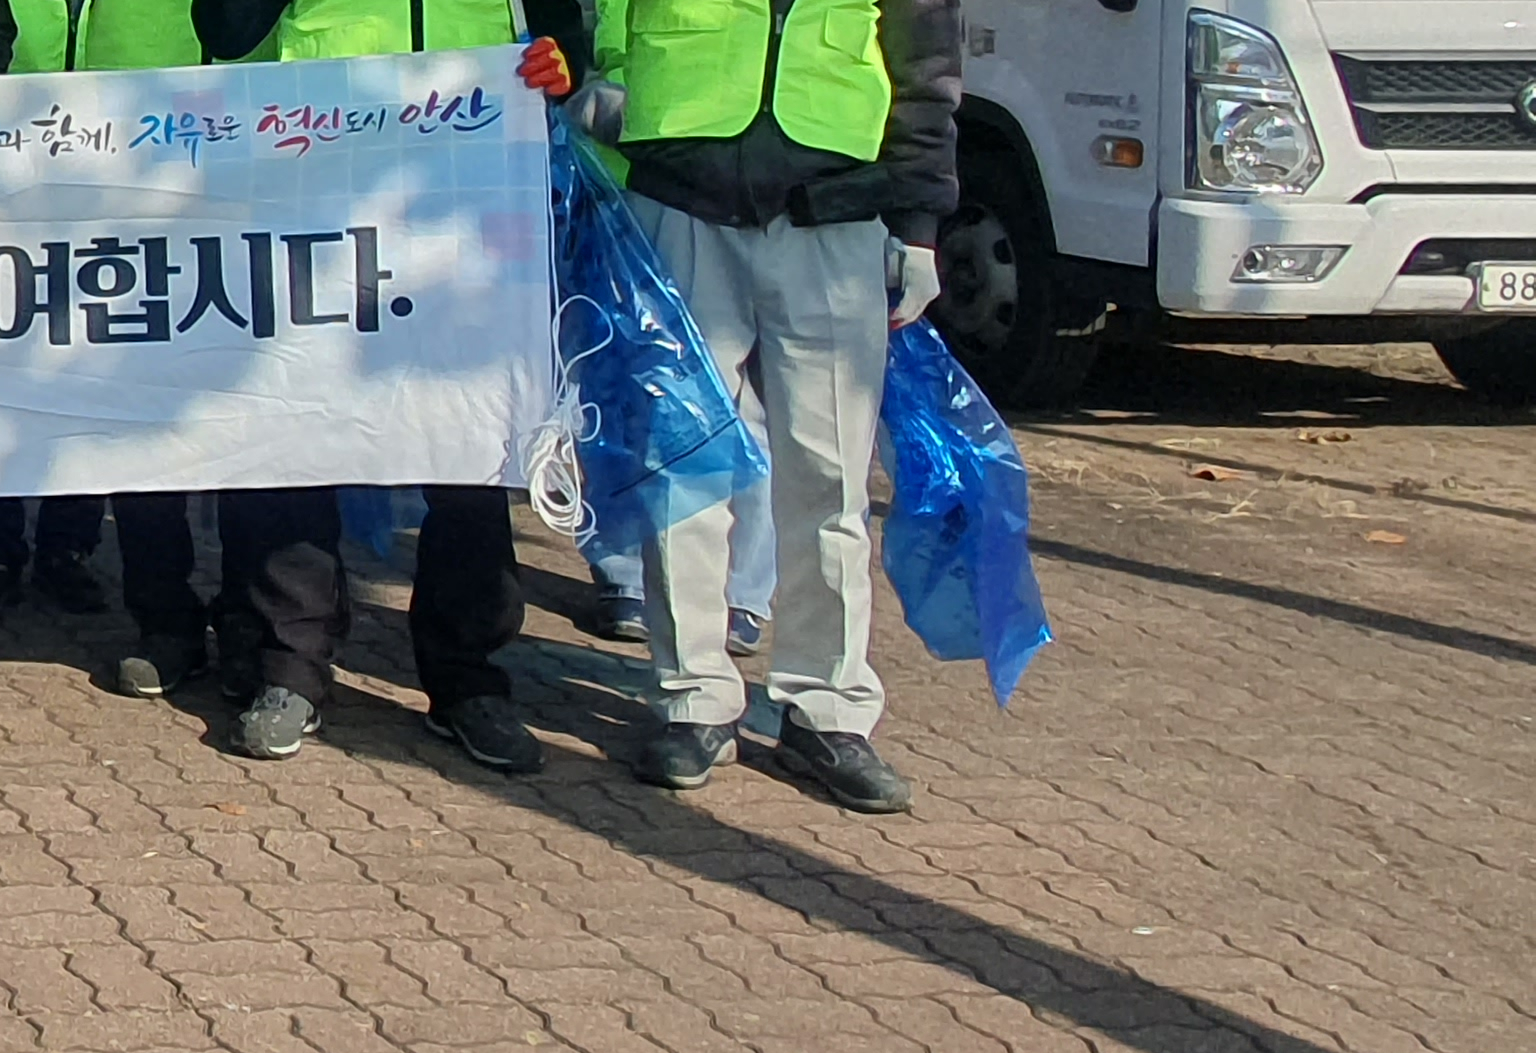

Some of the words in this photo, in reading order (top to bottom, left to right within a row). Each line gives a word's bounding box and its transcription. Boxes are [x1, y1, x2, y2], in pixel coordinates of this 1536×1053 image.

[128, 113, 242, 168] 자유로운
[256, 105, 386, 158] 혁신도시
[398, 86, 502, 133] 안산
